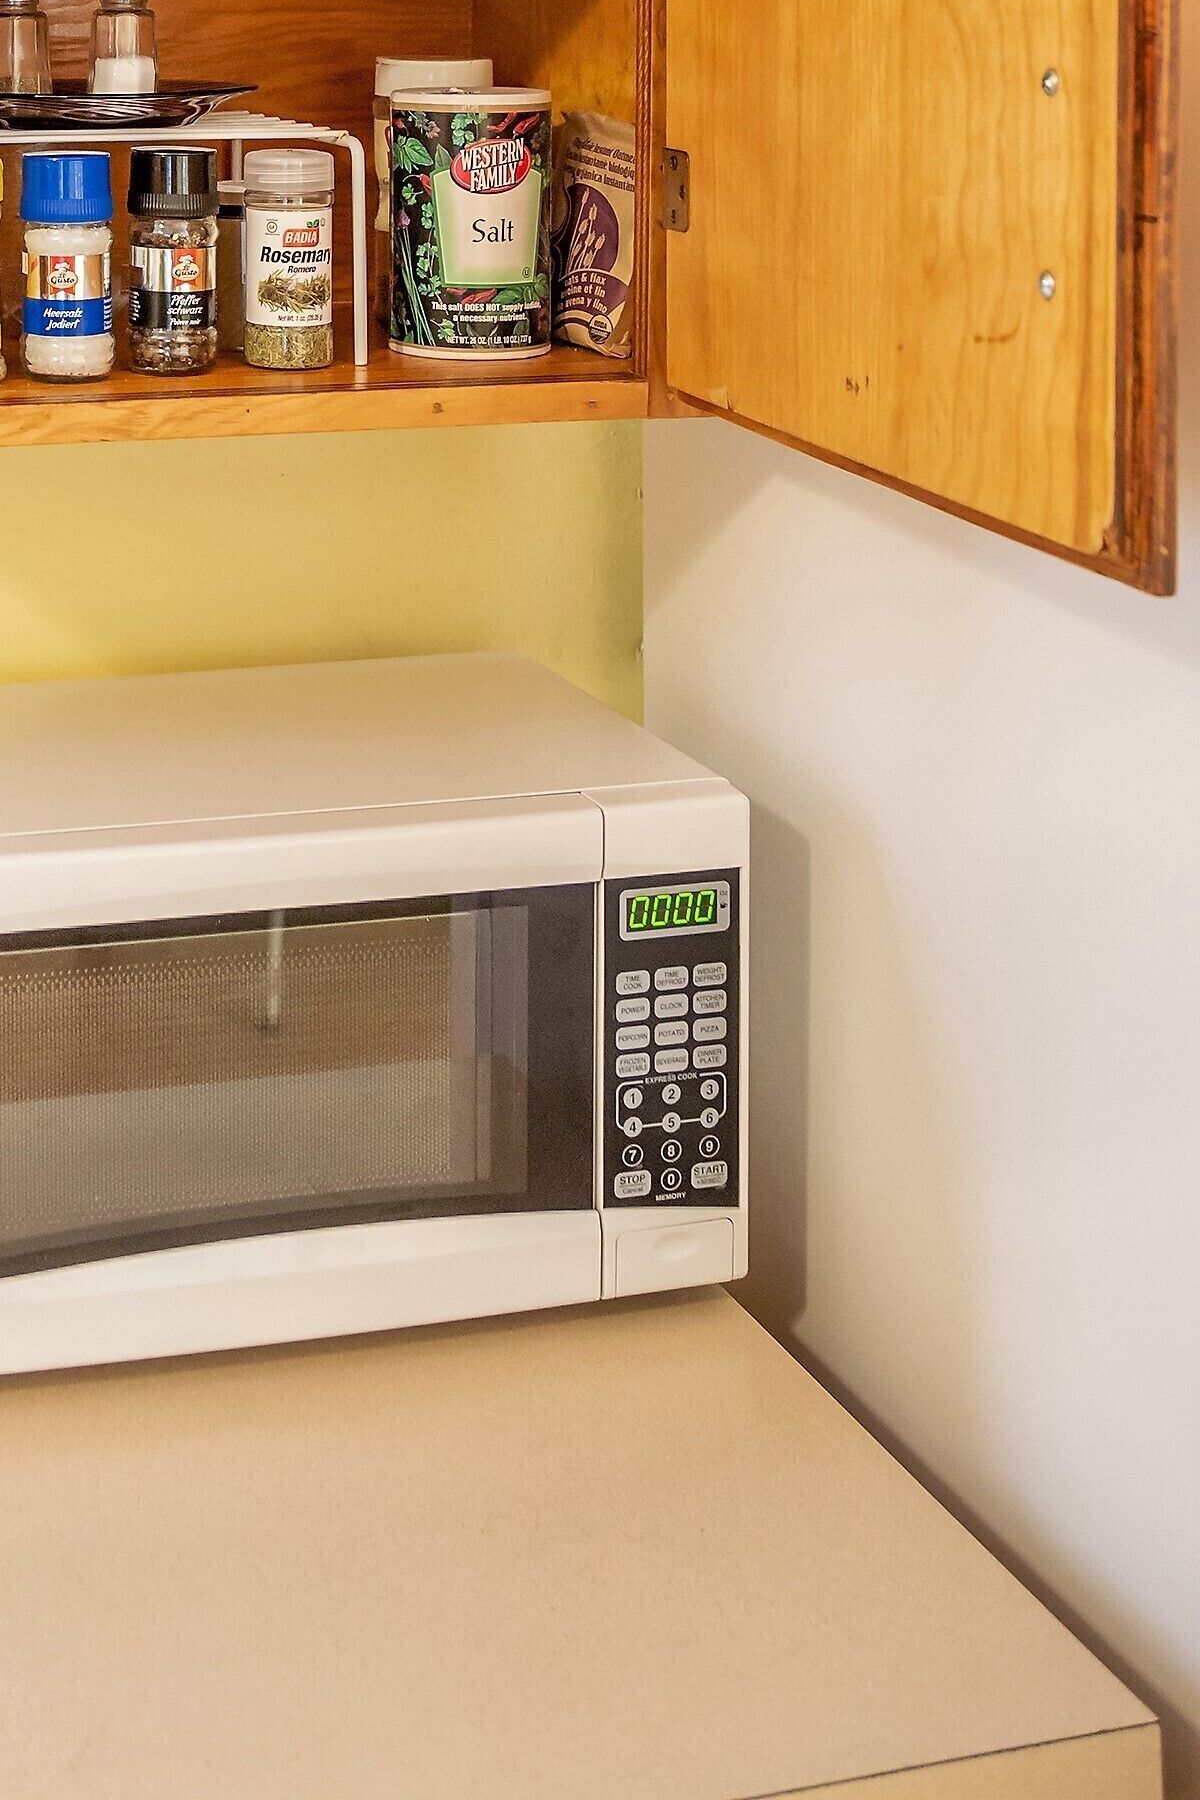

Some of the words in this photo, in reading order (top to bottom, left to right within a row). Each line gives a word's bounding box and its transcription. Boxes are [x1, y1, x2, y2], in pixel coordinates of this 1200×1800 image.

[460, 138, 525, 171] WESTERN
[470, 162, 518, 192] FAMILY
[472, 218, 514, 243] Salt
[285, 231, 317, 243] BADIA
[287, 265, 316, 273] Romero
[51, 275, 75, 285] Gusto
[581, 273, 588, 282] &
[590, 273, 607, 286] flax
[583, 284, 593, 294] et
[171, 294, 201, 306] Pfeffer
[565, 296, 585, 308] avena
[592, 298, 608, 314] lino
[167, 304, 203, 315] schwarz
[431, 301, 447, 311] This
[448, 302, 463, 311] salt
[464, 303, 484, 311] DOES
[485, 303, 500, 311] NOT
[501, 302, 523, 312] supply
[459, 314, 498, 323] necessary
[499, 313, 527, 322] nutrient.
[446, 336, 458, 344] NET
[629, 890, 715, 929] 0000
[697, 966, 722, 975] WEIGHT
[623, 983, 643, 991] COOK
[696, 994, 724, 1003] KITCHEN
[620, 1006, 646, 1015] POWER
[660, 1002, 683, 1011] CLOCK
[658, 1029, 685, 1037] POTATO
[700, 1025, 720, 1033] PIZZA
[699, 1056, 720, 1064] PLATE
[645, 1074, 676, 1084] EXPRESS
[677, 1072, 698, 1080] COOK
[668, 1089, 676, 1100] 2
[706, 1084, 713, 1095] 3
[630, 1092, 636, 1104] 1
[668, 1117, 675, 1128] 5
[706, 1112, 713, 1124] 6
[629, 1121, 636, 1133] 4
[667, 1145, 675, 1157] 8
[705, 1140, 713, 1152] 9
[628, 1149, 637, 1161] 7
[694, 1164, 725, 1175] START
[620, 1173, 646, 1185] STOP
[667, 1173, 675, 1186] 0
[656, 1191, 687, 1201] MEMORY
